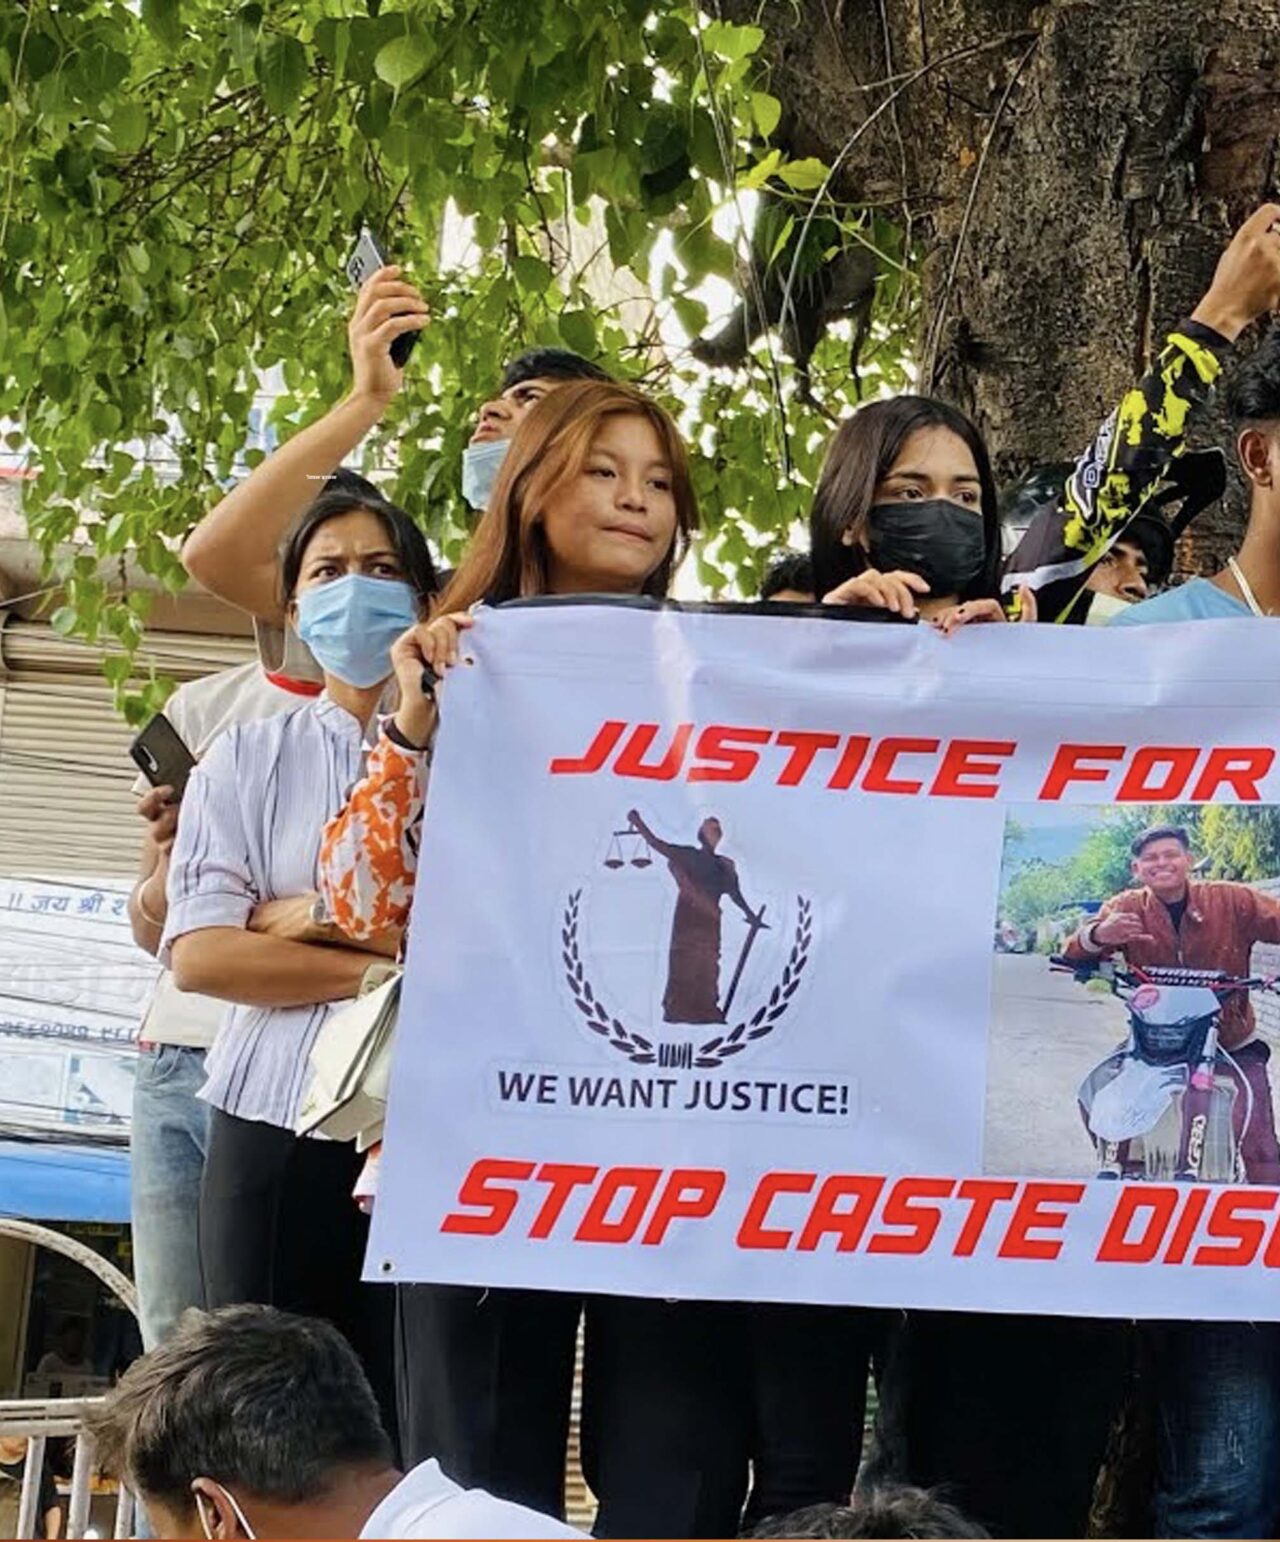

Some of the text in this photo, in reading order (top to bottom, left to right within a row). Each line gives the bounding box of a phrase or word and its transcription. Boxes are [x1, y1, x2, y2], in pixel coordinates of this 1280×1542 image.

[548, 718, 1016, 799] JUSTICE
[1037, 742, 1278, 804] FOR
[498, 1071, 849, 1115] WE WANT JUSTICE!
[440, 1157, 728, 1247] STOP
[735, 1169, 1087, 1262] CASTE
